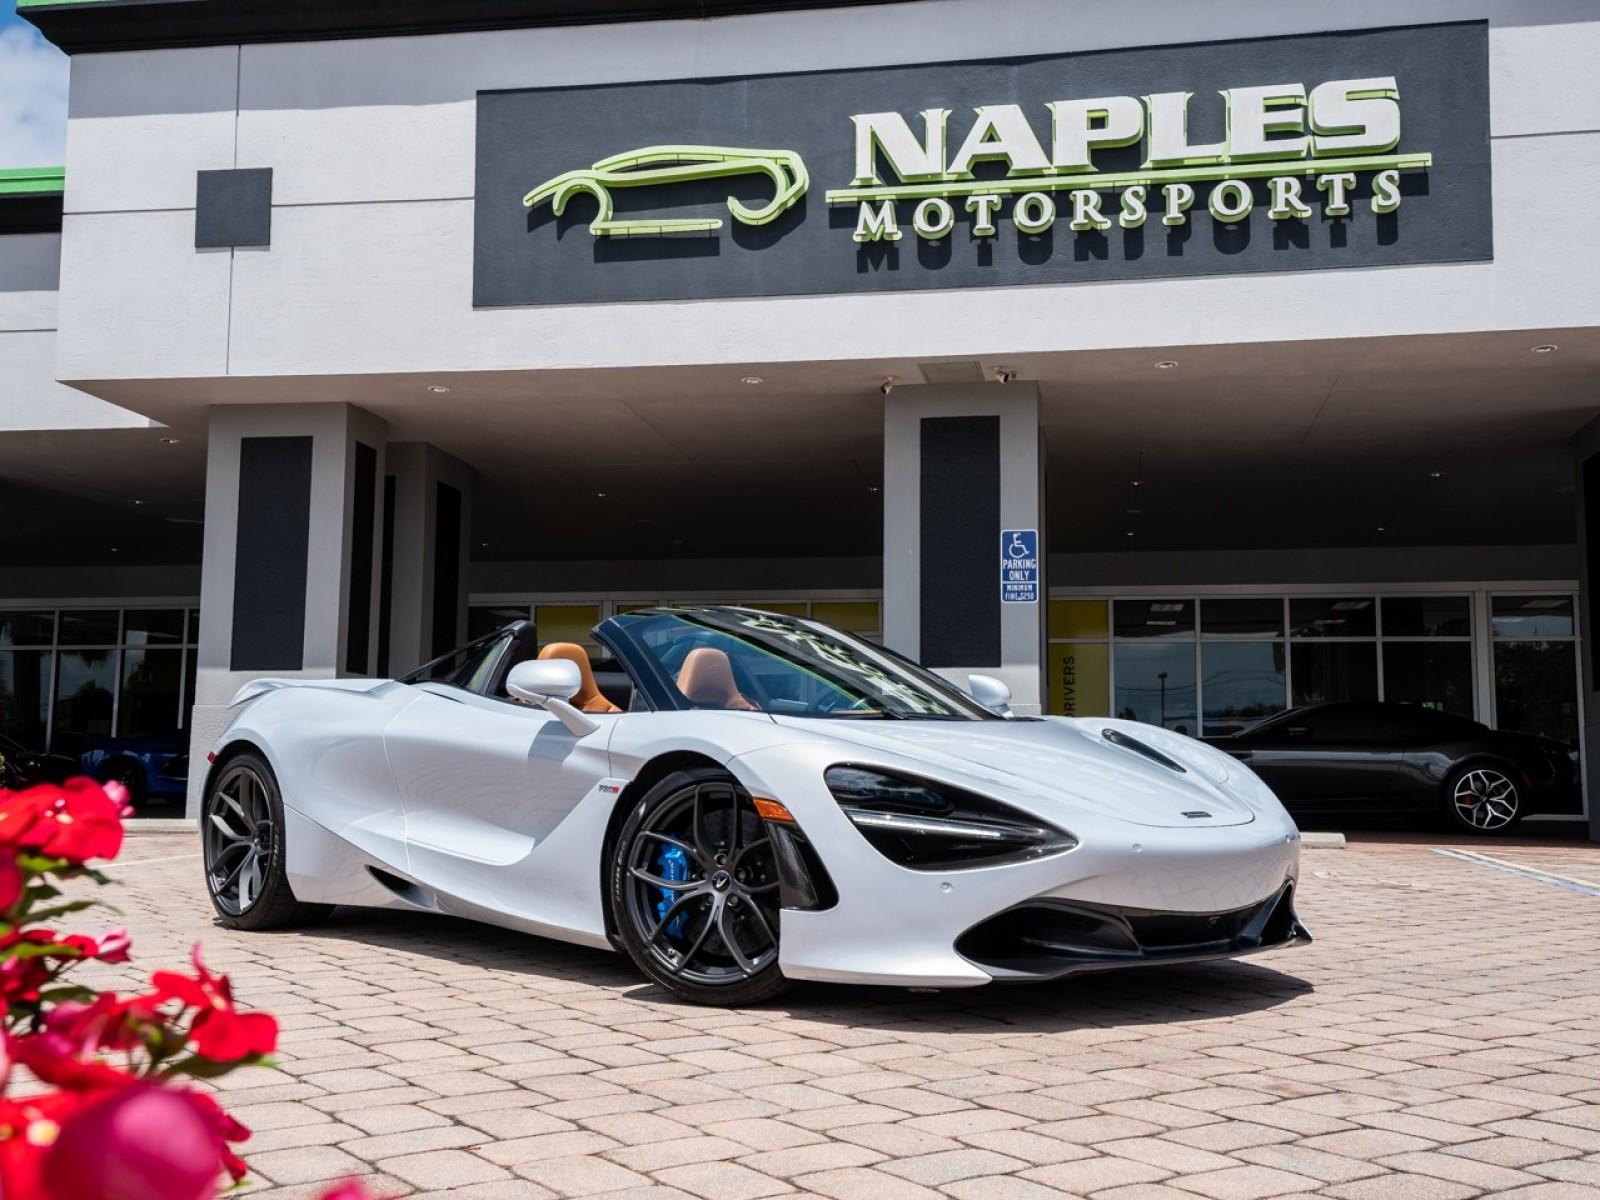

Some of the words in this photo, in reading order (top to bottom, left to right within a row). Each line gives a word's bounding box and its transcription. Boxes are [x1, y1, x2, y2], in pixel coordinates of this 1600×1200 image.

[849, 76, 1400, 186] NAPLES
[853, 170, 1400, 242] MOTORSPORTS
[1002, 559, 1037, 569] PARKING
[1009, 570, 1030, 581] ONLY
[1006, 584, 1033, 592] MINIMUM
